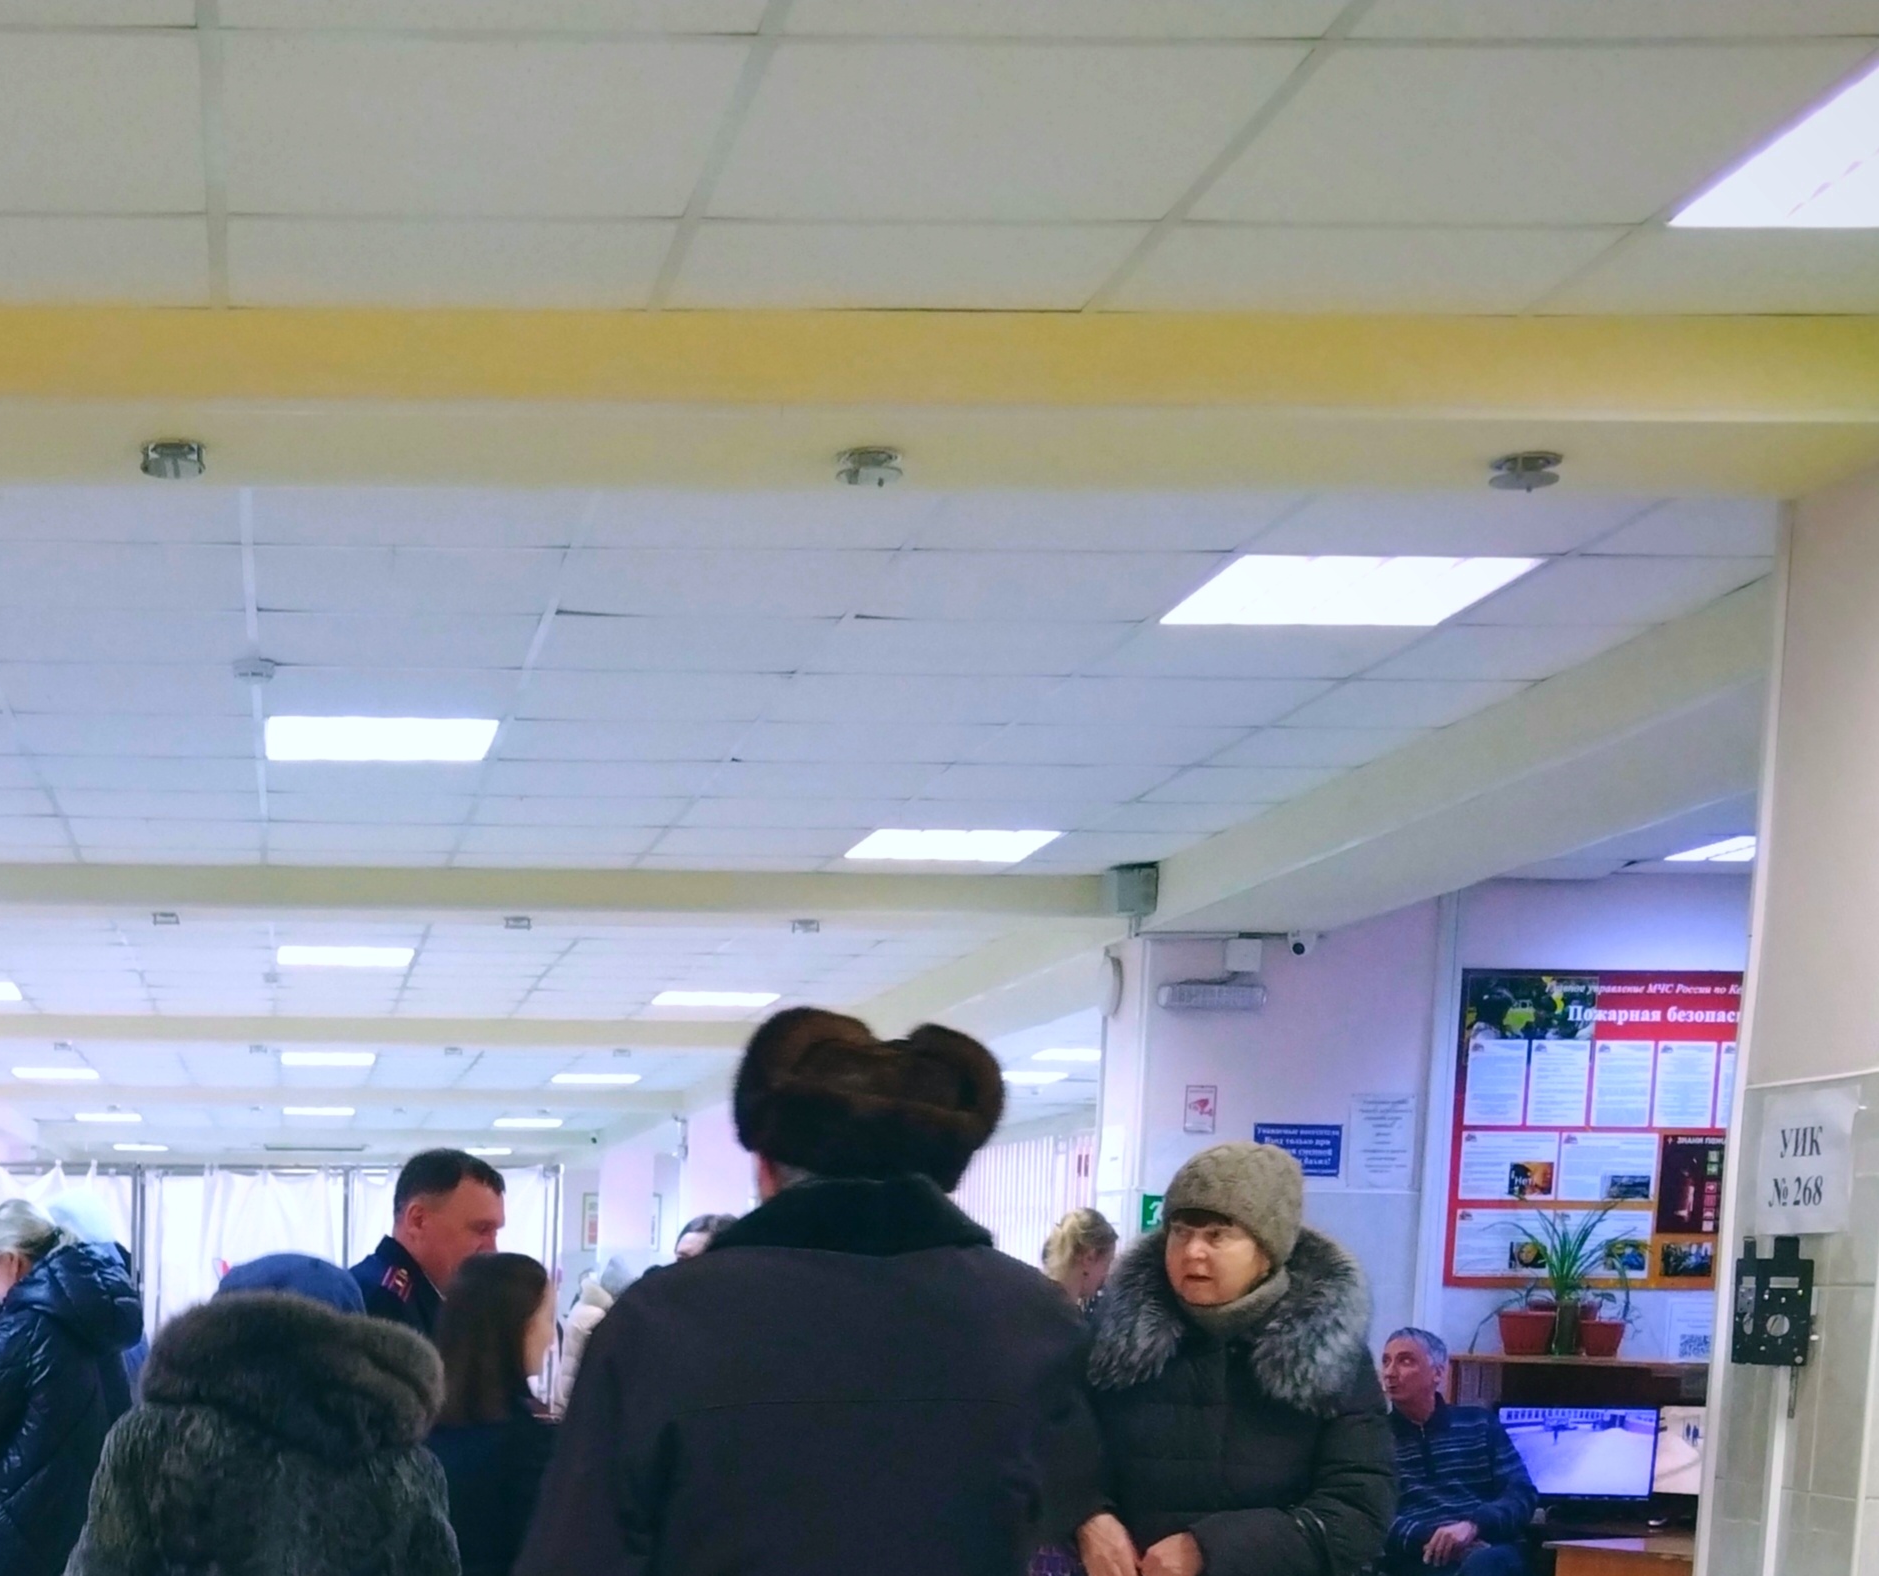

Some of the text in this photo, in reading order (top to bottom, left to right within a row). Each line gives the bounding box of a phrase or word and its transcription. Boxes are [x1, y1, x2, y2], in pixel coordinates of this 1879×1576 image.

[1646, 983, 1674, 995] МЧС
[1676, 984, 1711, 995] России
[1713, 986, 1726, 995] по
[1567, 1005, 1662, 1025] Пожарная
[1779, 1125, 1823, 1159] УИК
[1792, 1175, 1824, 1207] 268
